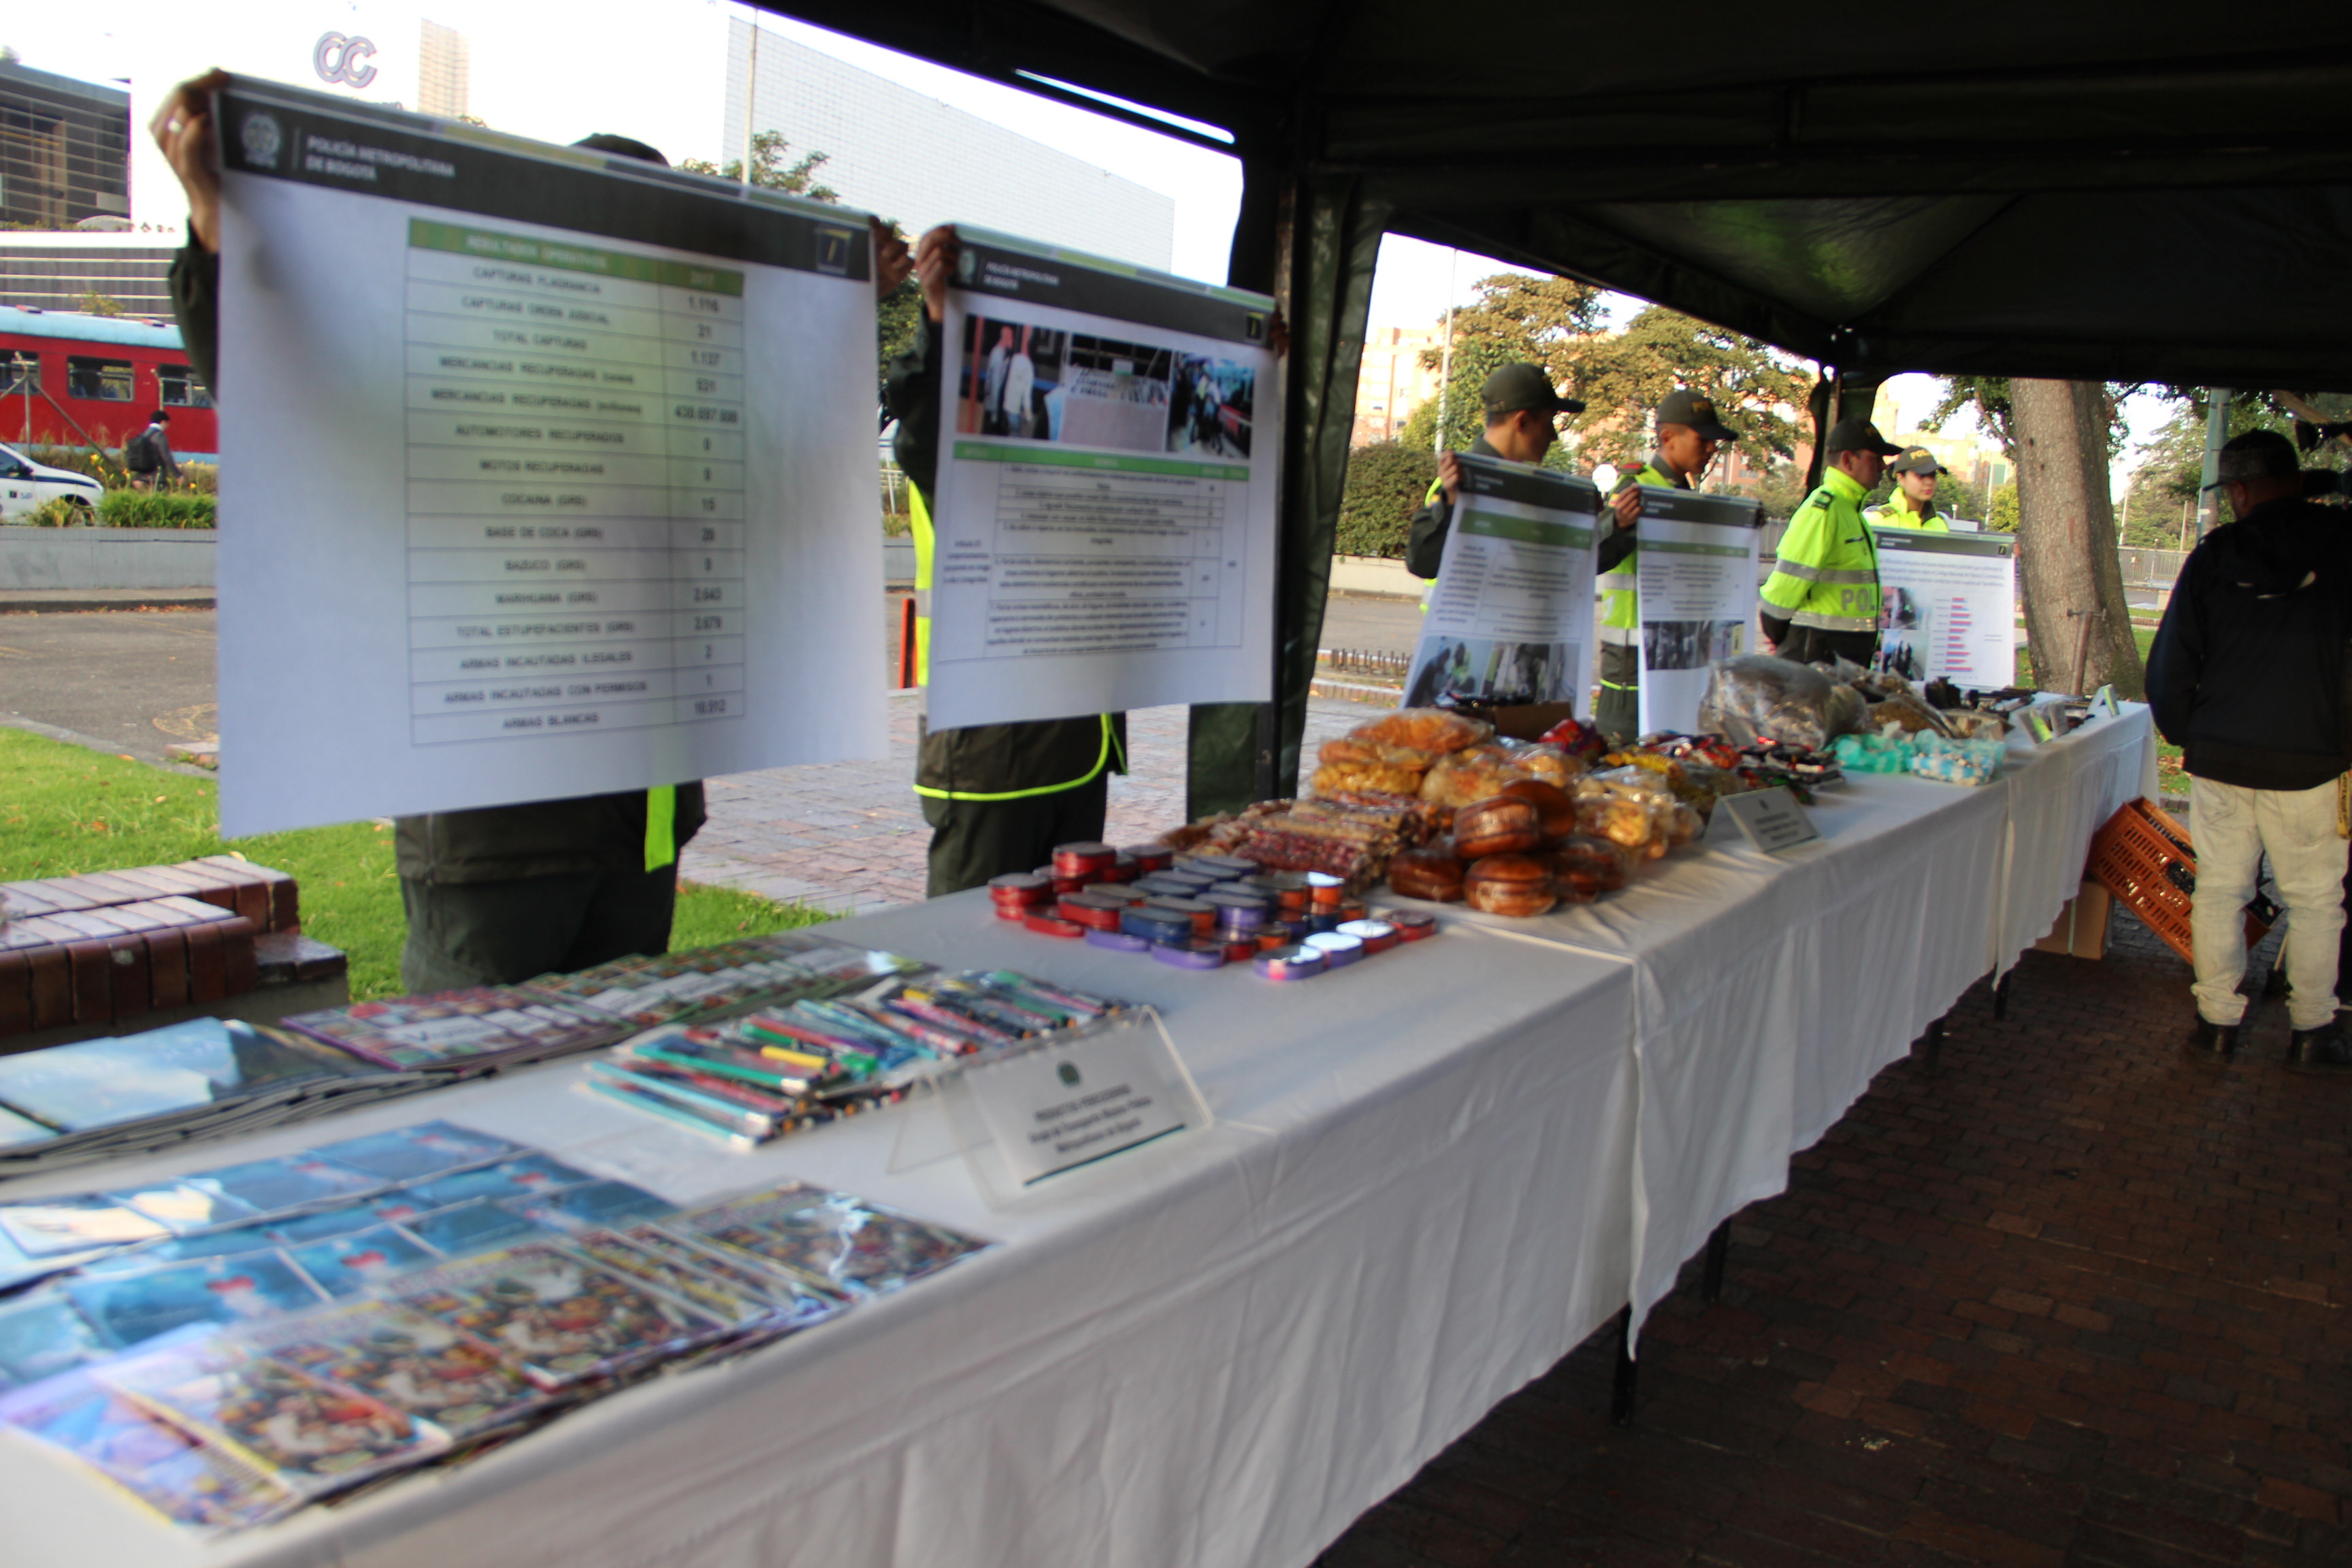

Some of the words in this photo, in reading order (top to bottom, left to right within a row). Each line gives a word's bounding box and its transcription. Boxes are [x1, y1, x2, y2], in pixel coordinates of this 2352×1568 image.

[305, 154, 323, 172] DE
[358, 144, 456, 178] METROPOLITANA
[472, 265, 533, 284] CAPTURAS
[536, 274, 601, 293] FLAGRANCIA
[461, 295, 523, 313] CAPTURAS
[568, 308, 610, 325] JUDICIAL
[493, 329, 528, 344] TOTAL
[532, 333, 587, 350] CAPTURAS
[519, 526, 535, 538] DE
[455, 625, 492, 638] TOTAL
[459, 657, 500, 670] ARMAS
[504, 653, 576, 668] INCAUTADAS
[443, 689, 485, 703] ARMAS
[489, 685, 562, 700] INCAUTADAS
[567, 684, 591, 696] CON
[502, 715, 542, 729] ARMAS
[547, 712, 599, 727] BLANCAS
